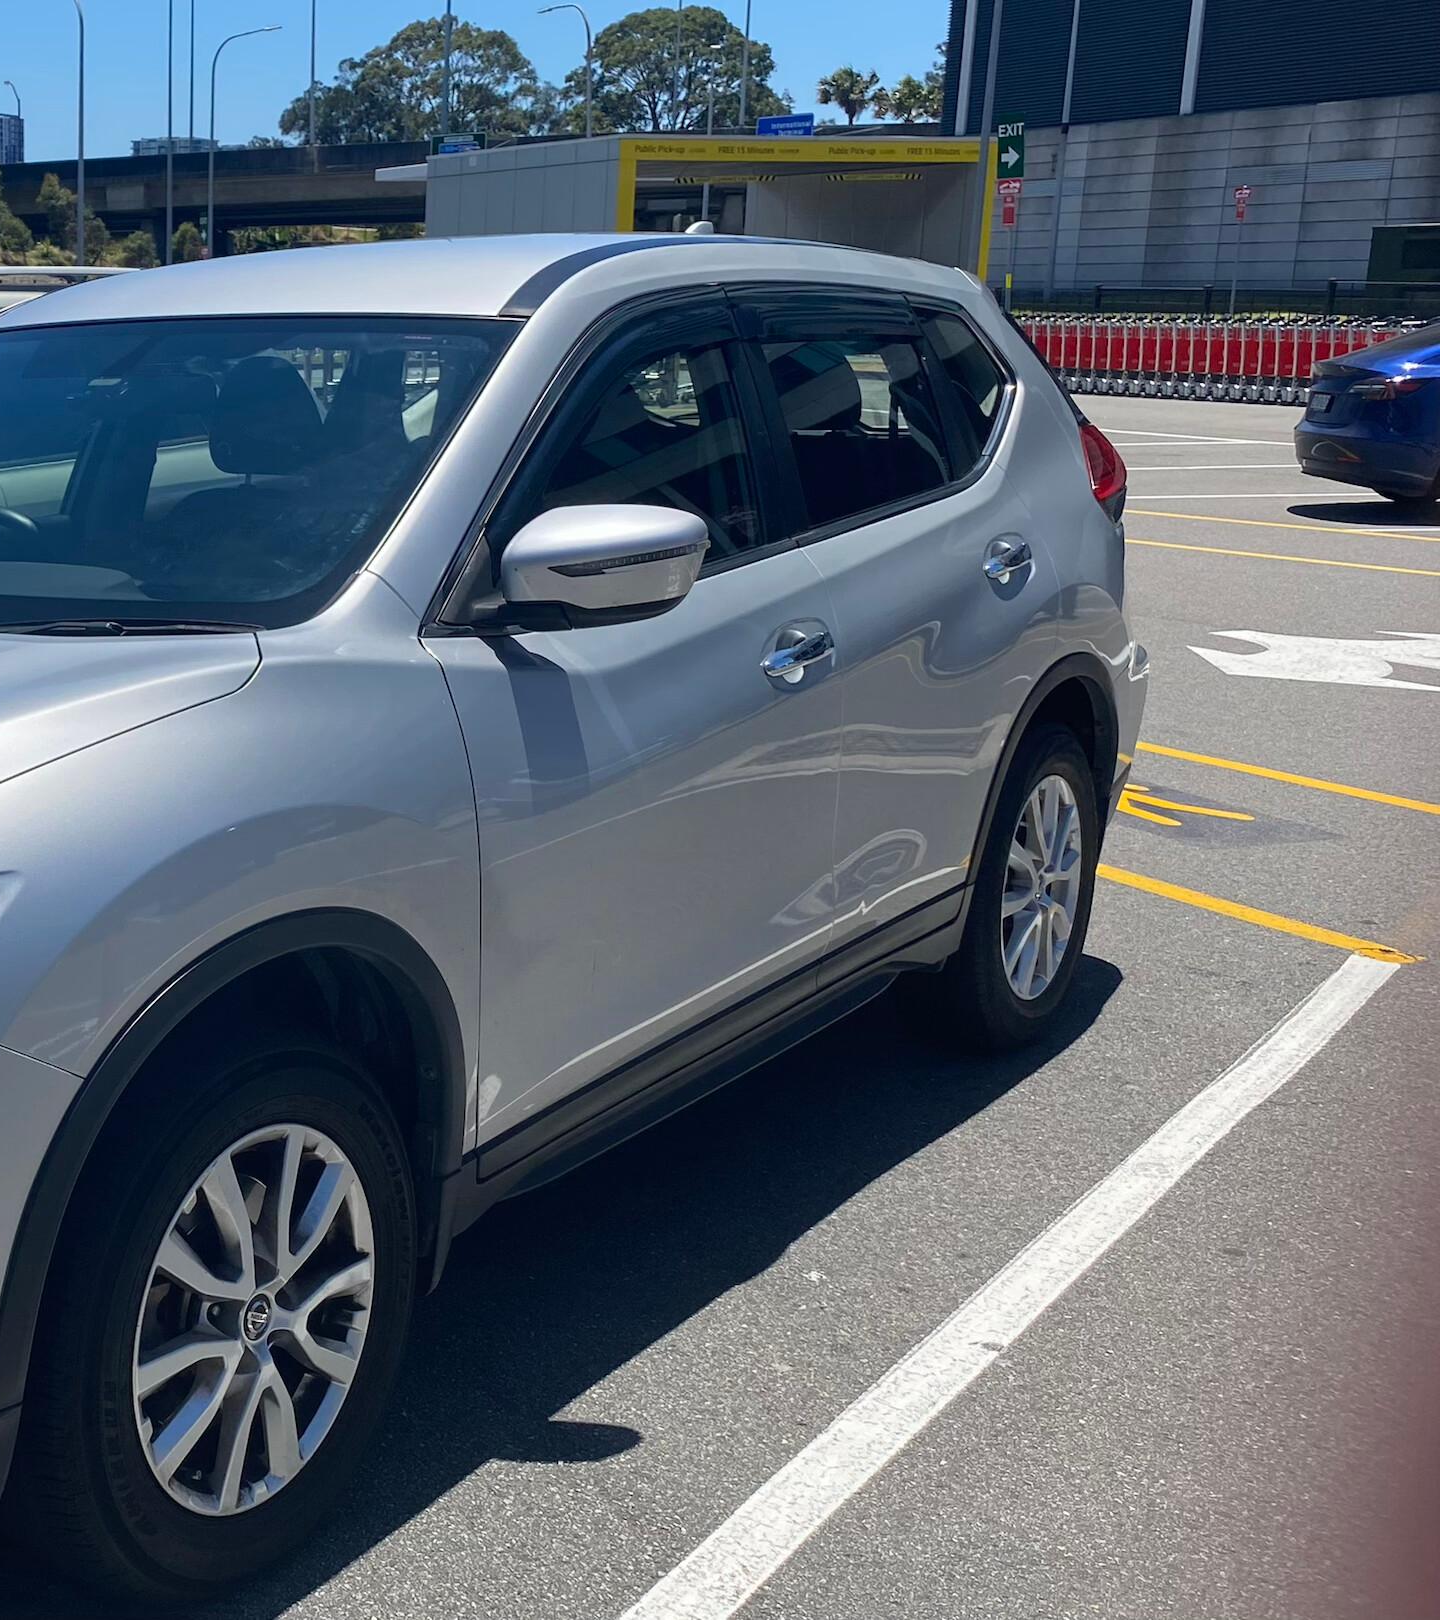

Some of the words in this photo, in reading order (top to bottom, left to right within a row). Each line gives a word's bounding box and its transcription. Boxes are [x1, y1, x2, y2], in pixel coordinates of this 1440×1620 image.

[998, 123, 1024, 138] EXIT
[634, 145, 656, 153] Public
[657, 145, 685, 154] Pick-up
[718, 146, 735, 154] FREE
[736, 146, 745, 154] 15
[747, 146, 775, 154] Minutes
[828, 147, 849, 155] Public
[907, 147, 923, 155] FREE
[924, 147, 933, 155] 15
